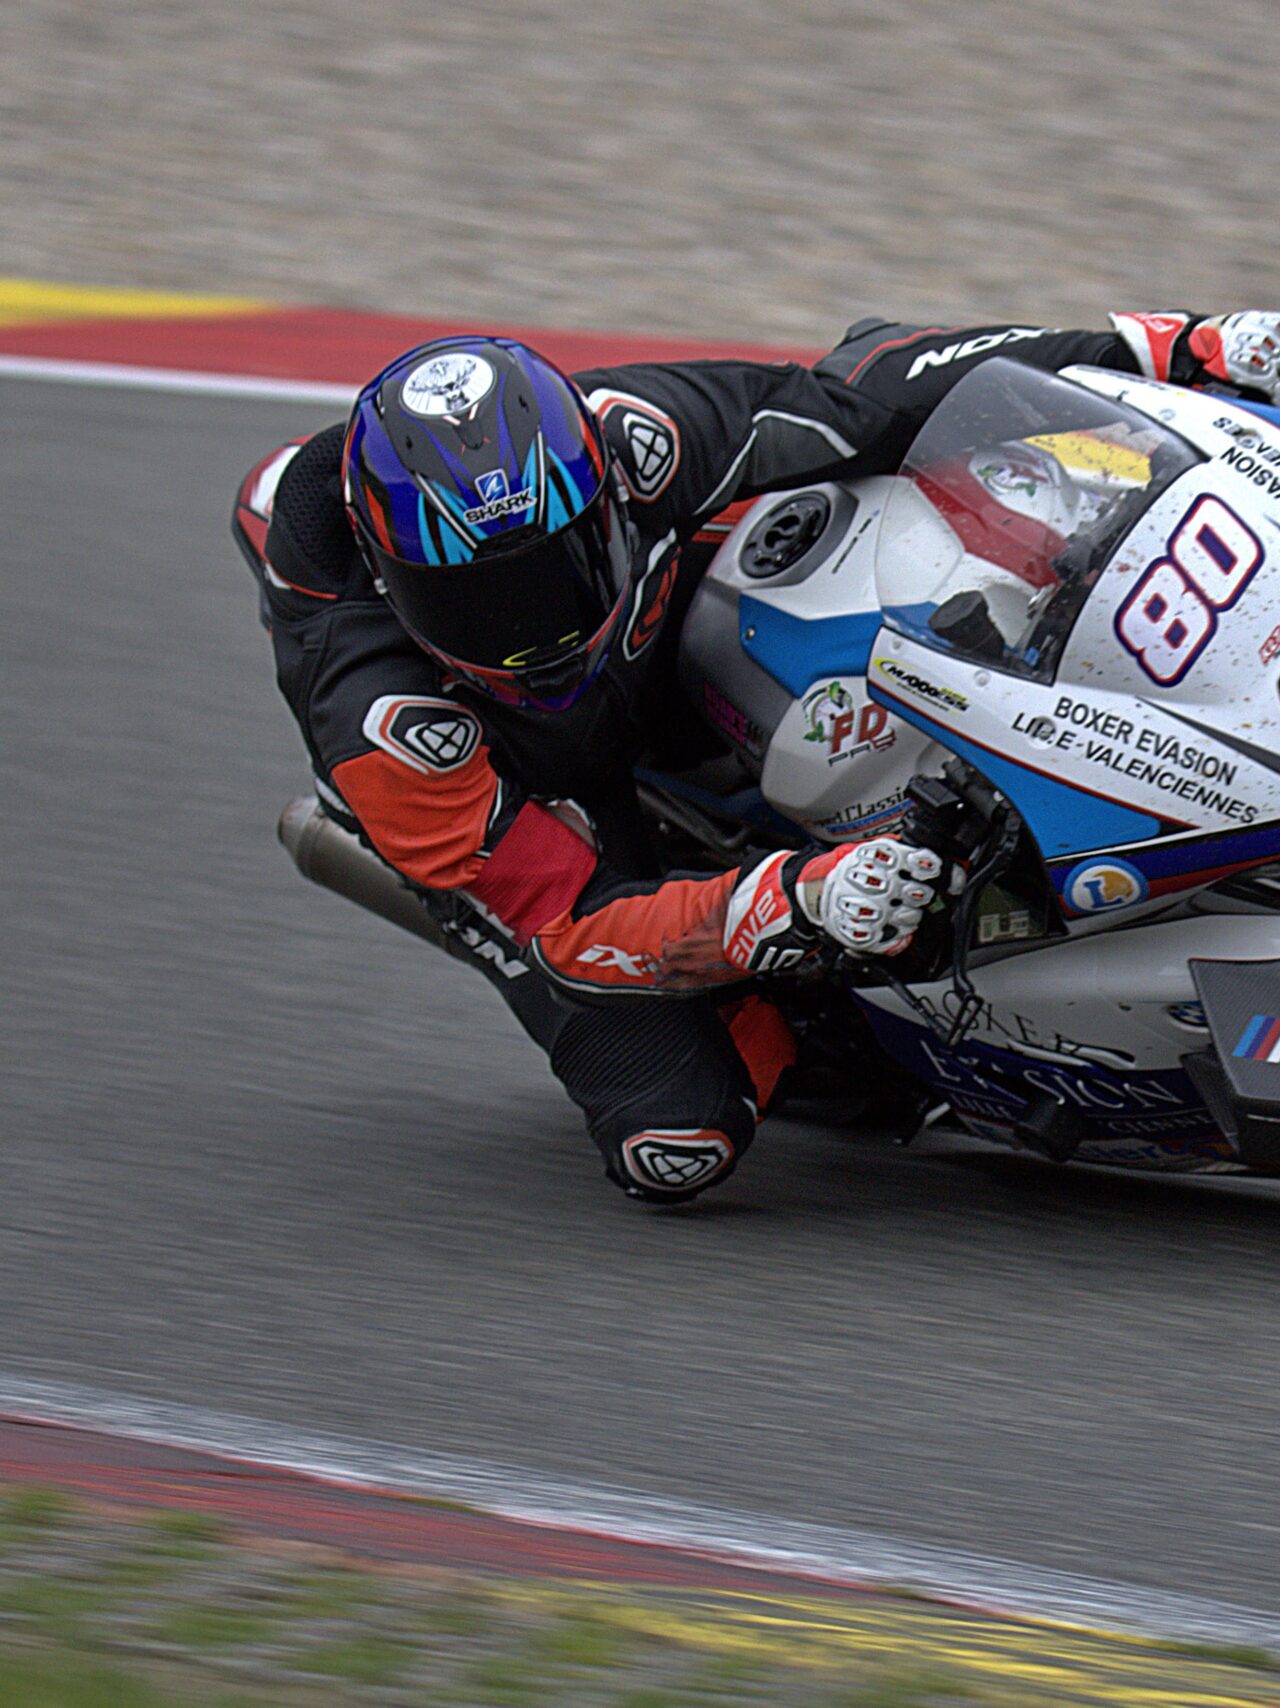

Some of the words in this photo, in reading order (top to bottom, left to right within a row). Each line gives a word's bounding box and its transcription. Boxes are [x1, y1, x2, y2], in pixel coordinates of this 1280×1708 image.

[465, 489, 536, 524] SHARK
[1113, 492, 1266, 688] 80
[831, 702, 888, 754] FD
[1053, 695, 1135, 745] BOXER
[1135, 728, 1239, 786] EVASION
